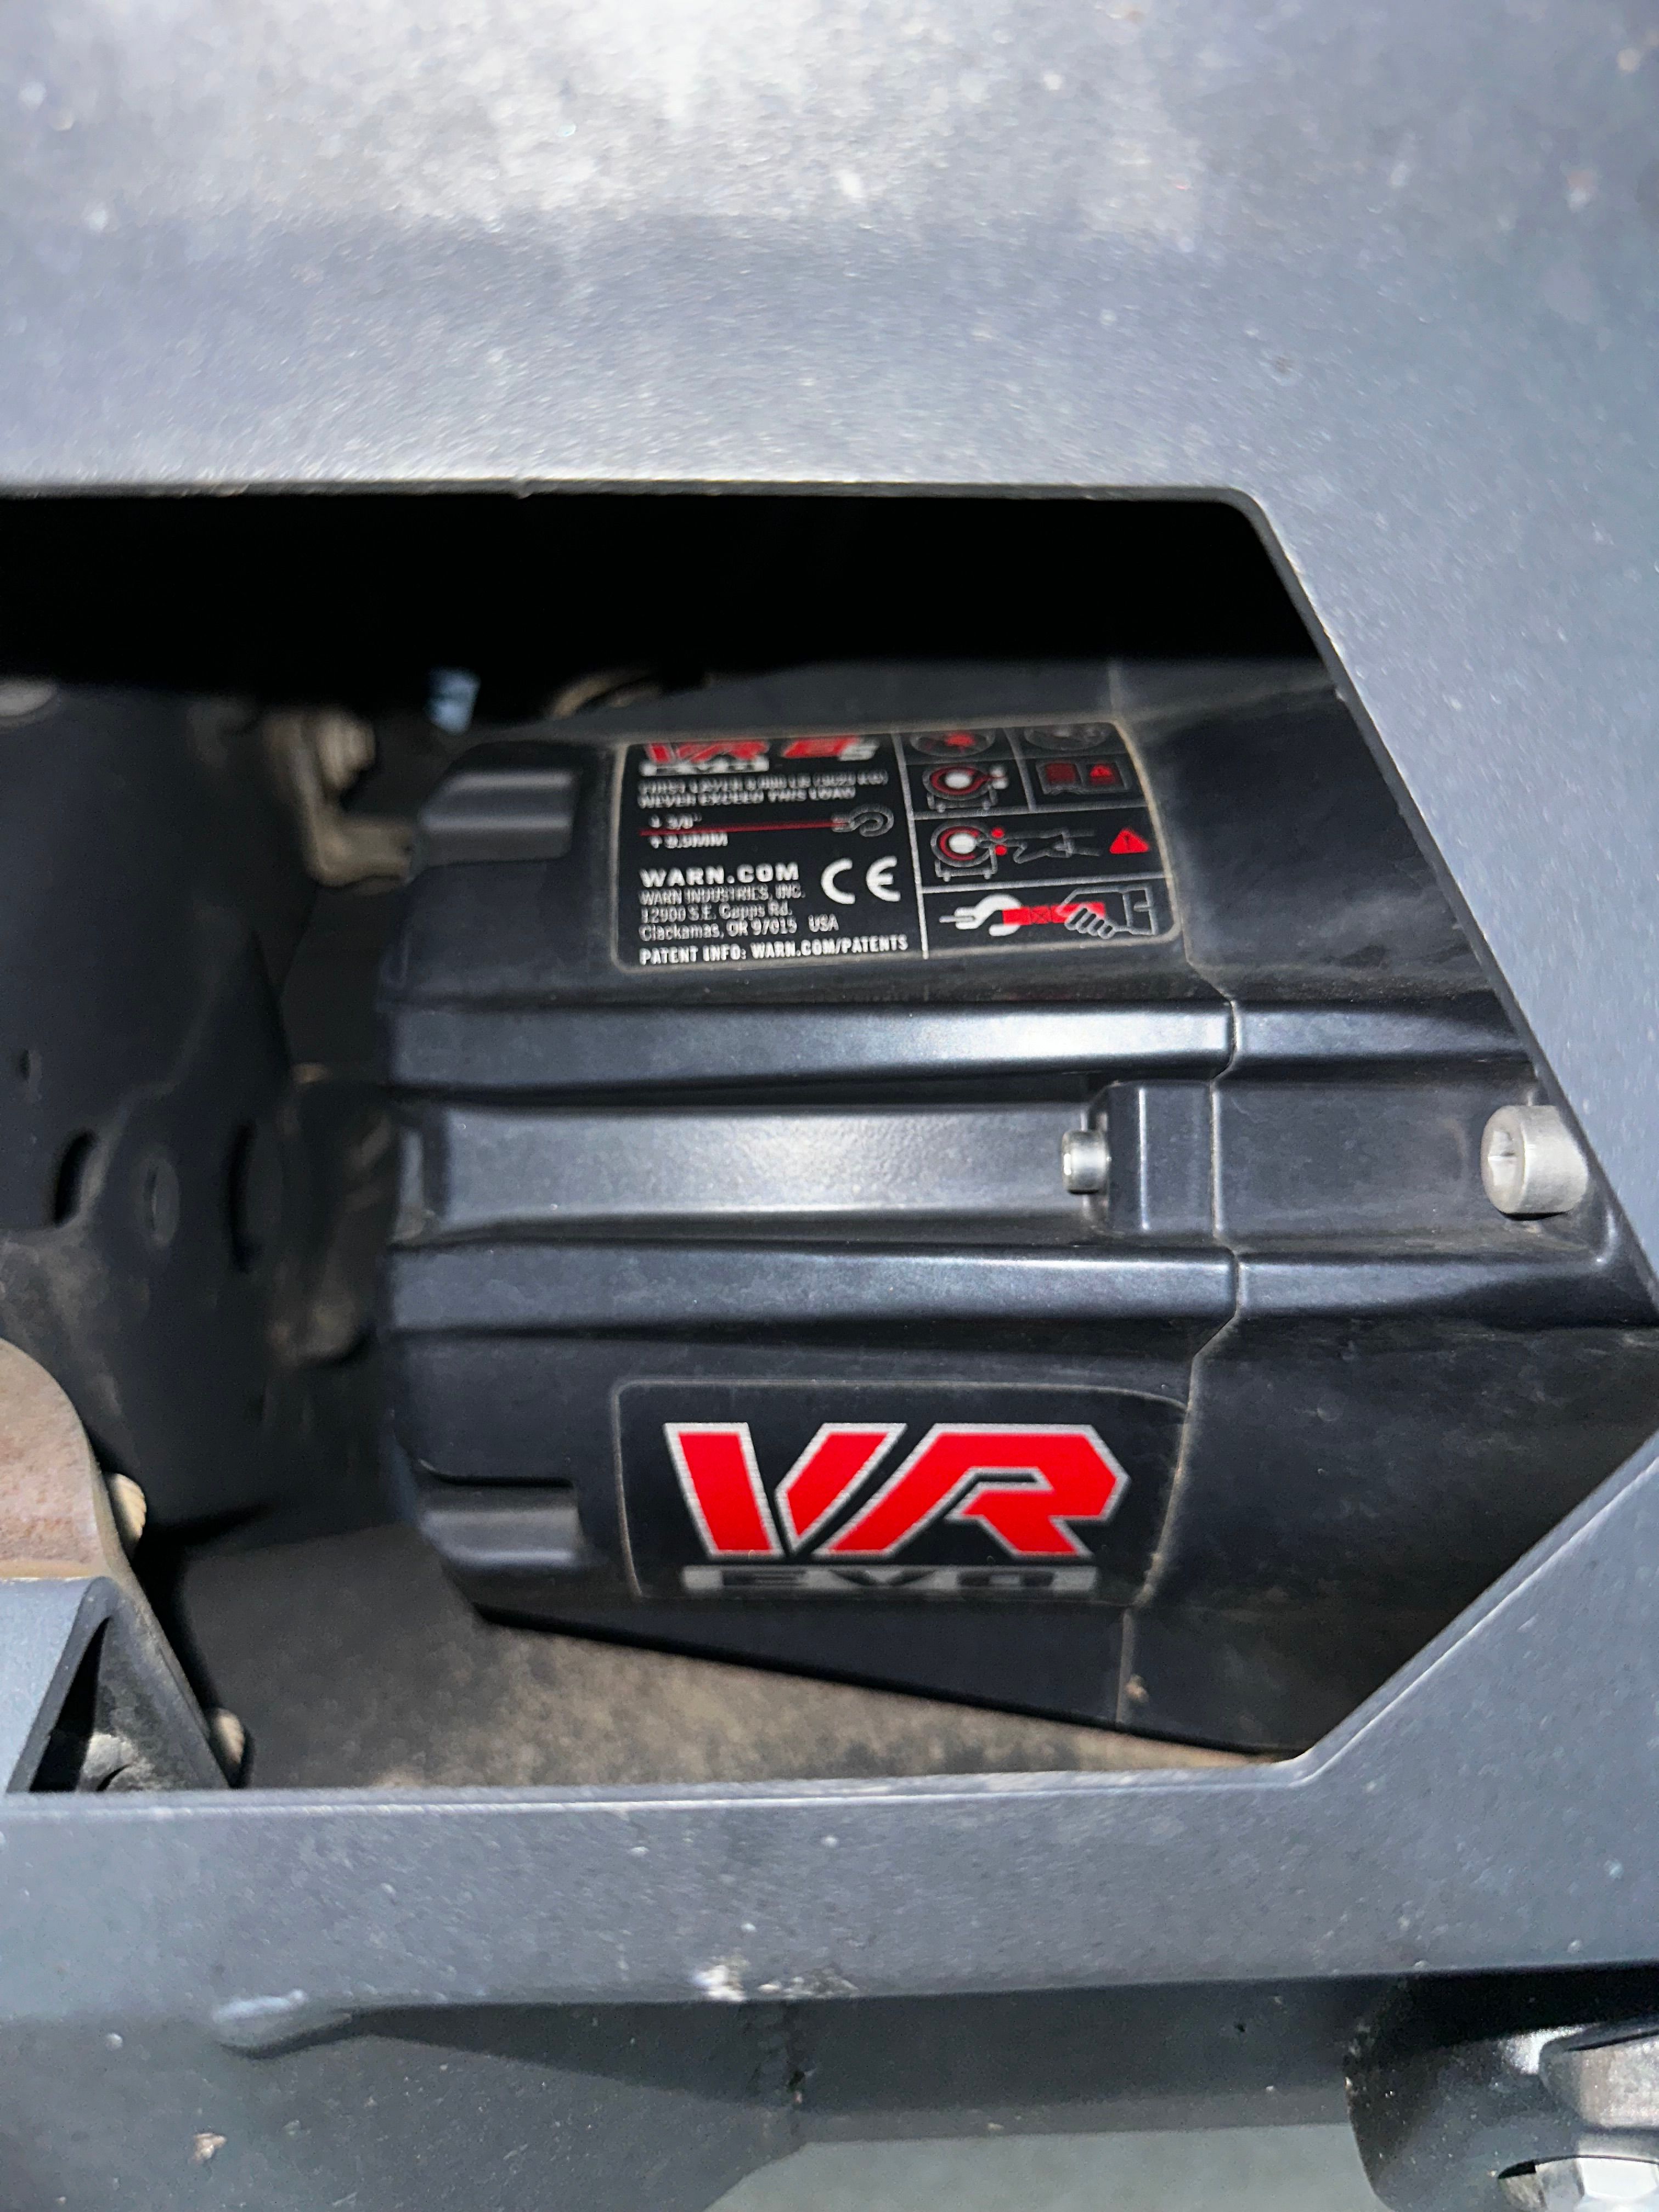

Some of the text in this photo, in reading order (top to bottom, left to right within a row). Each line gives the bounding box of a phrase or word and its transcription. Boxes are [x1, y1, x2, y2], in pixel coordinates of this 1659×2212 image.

[639, 863, 799, 888] WARN.COM
[821, 855, 901, 904] CE
[639, 888, 682, 905] WARN
[775, 882, 806, 899] INC.
[641, 905, 686, 923] 12900
[726, 918, 749, 937] OR
[808, 913, 839, 933] USA
[639, 934, 909, 966] PATENT INFO: WARN.COM/PATENTS
[663, 1422, 1131, 1560] VR
